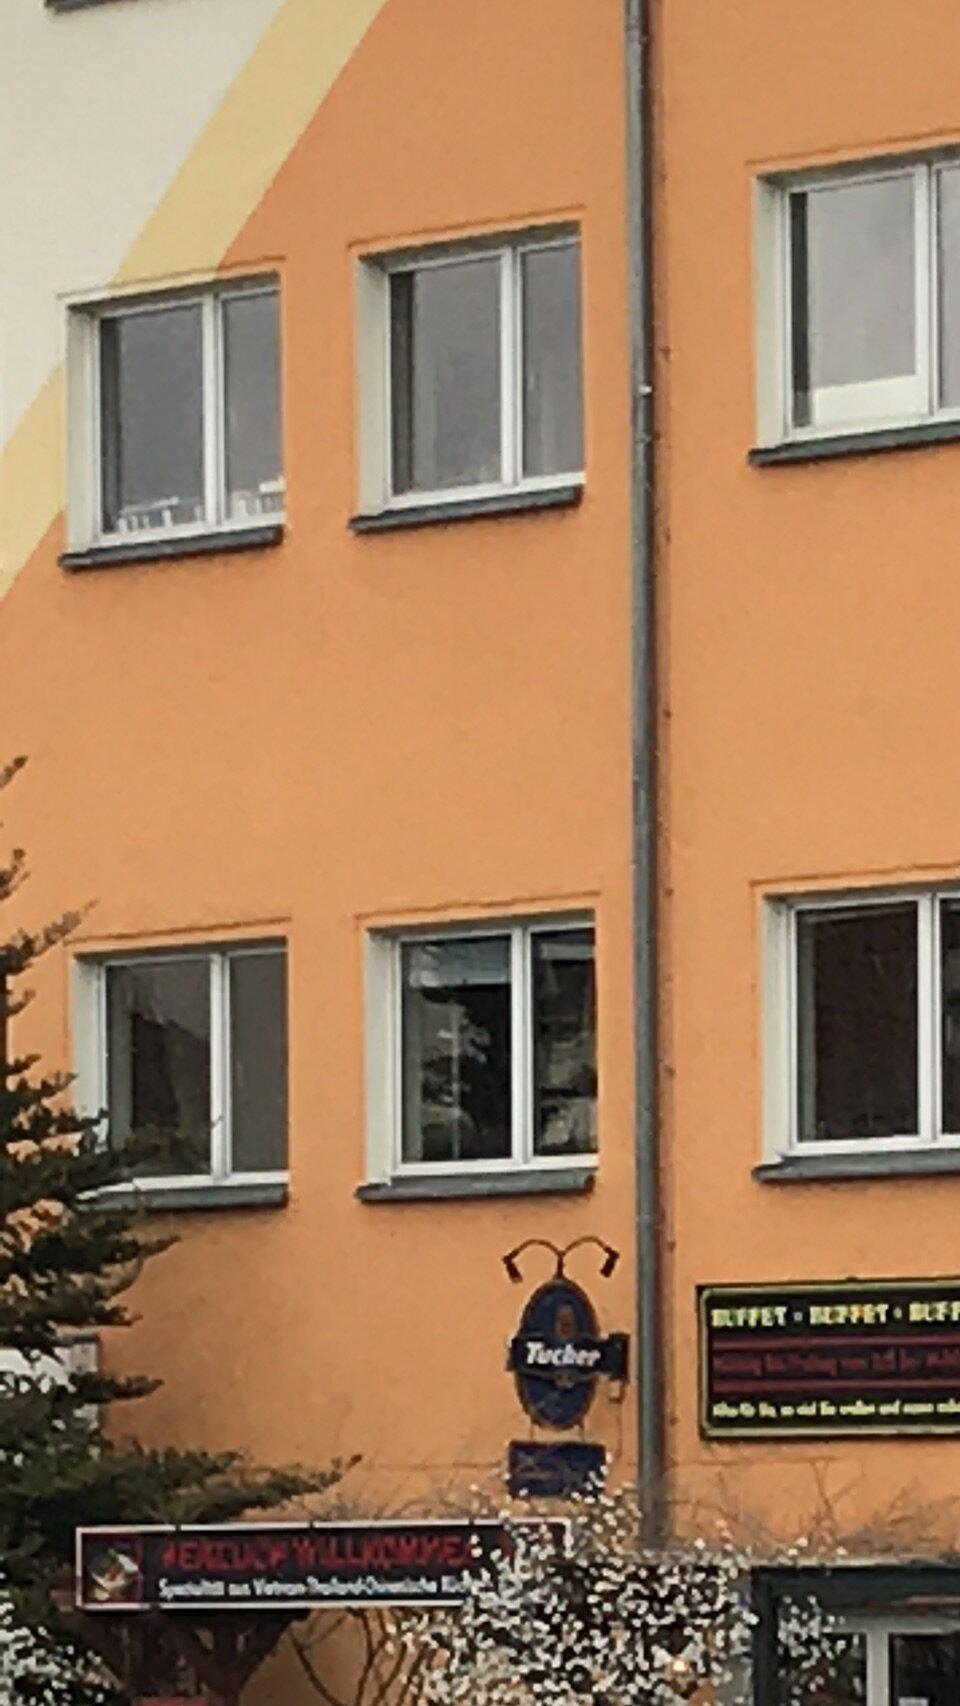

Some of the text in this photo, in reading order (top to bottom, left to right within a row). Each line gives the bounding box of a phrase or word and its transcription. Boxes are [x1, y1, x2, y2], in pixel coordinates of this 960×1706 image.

[711, 1306, 787, 1328] BUFFET
[810, 1304, 889, 1326] BUFFET
[526, 1341, 601, 1367] Tucher
